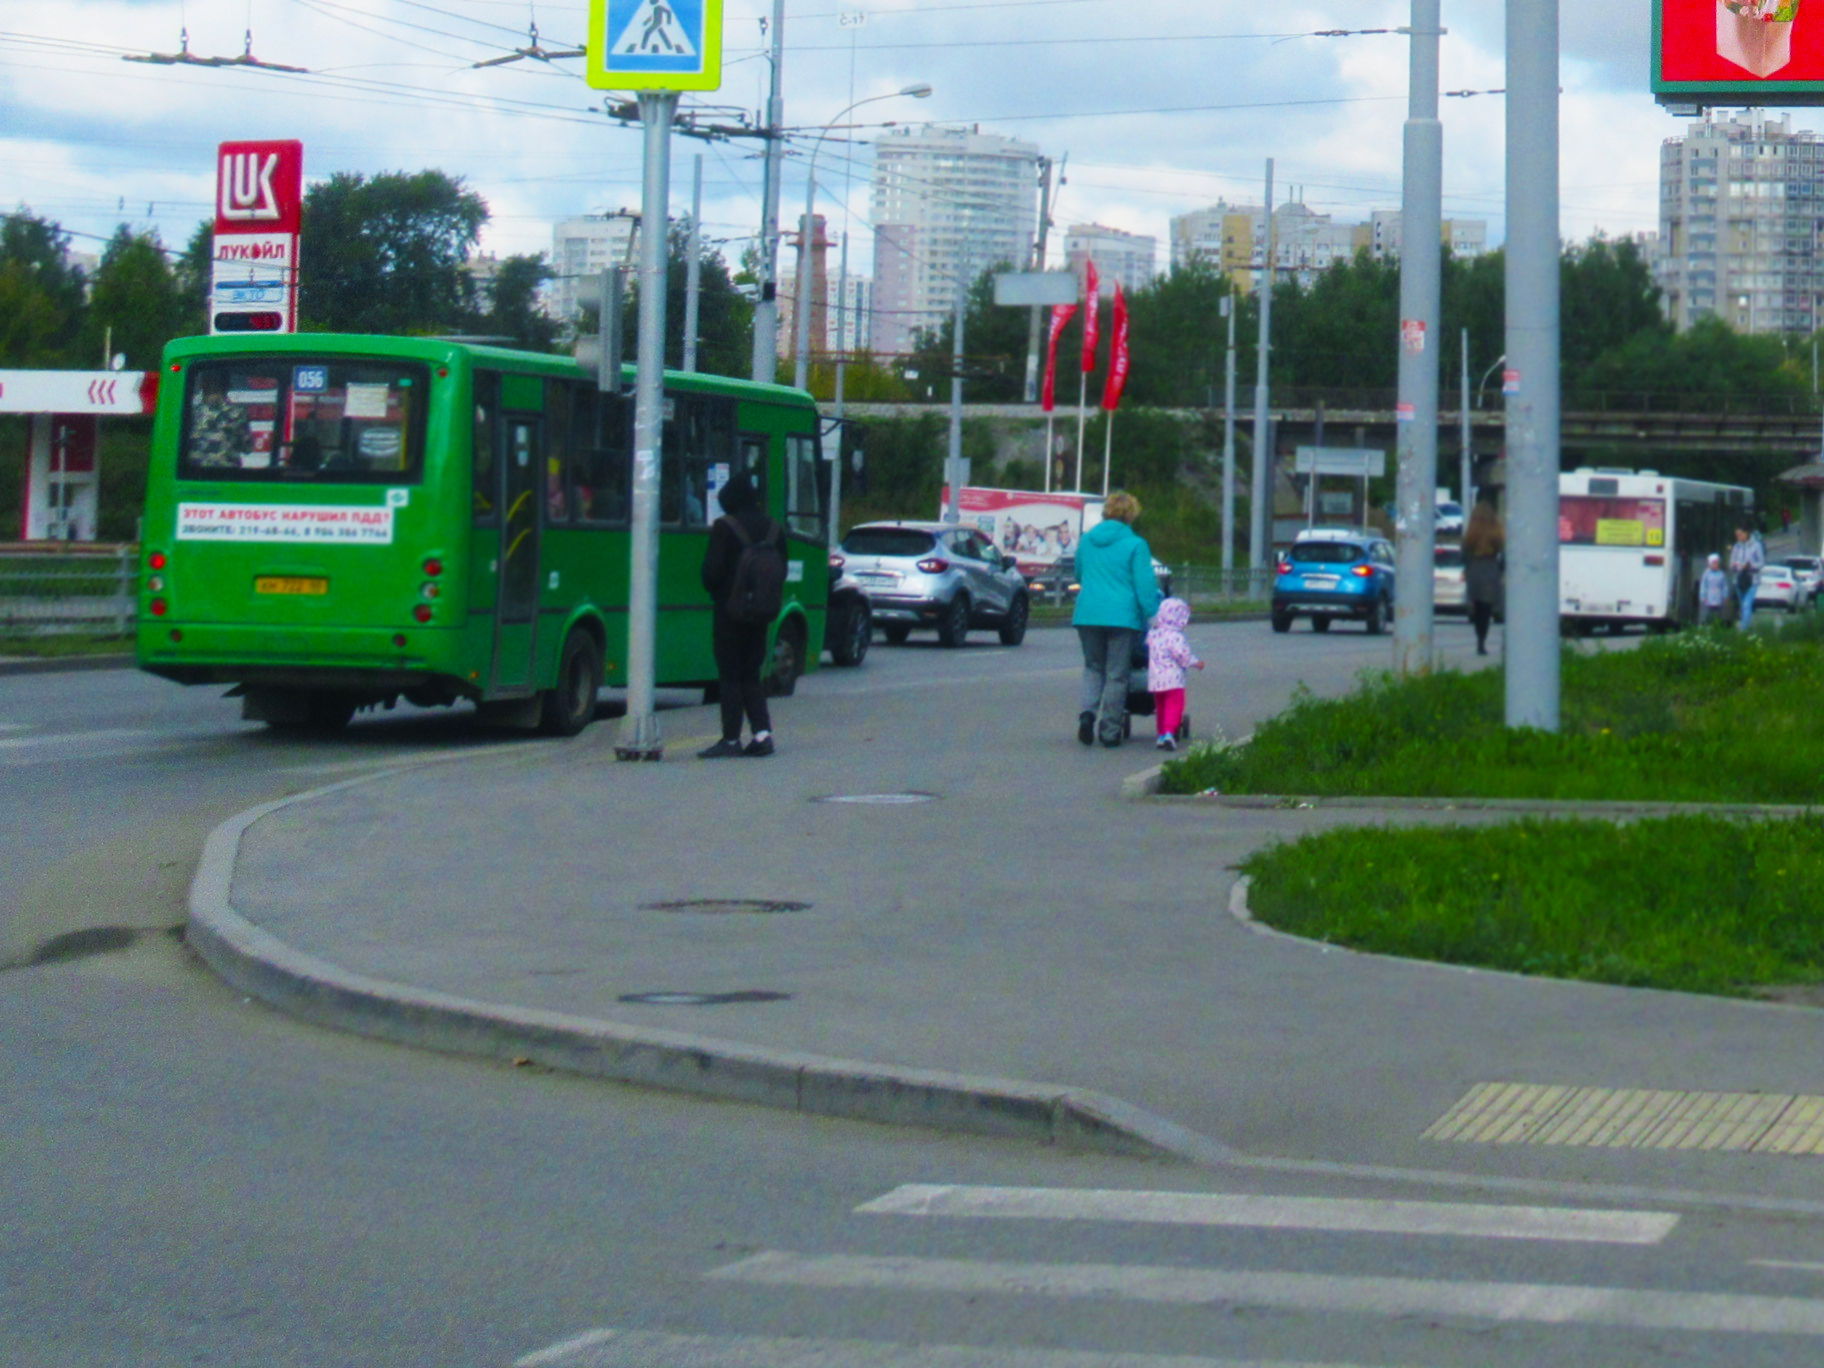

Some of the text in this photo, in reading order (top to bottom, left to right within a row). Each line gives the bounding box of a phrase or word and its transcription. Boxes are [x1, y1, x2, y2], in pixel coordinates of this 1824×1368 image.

[184, 508, 391, 525] ЭТОТ АВТОБУС НАРУШИЛ ПДД?
